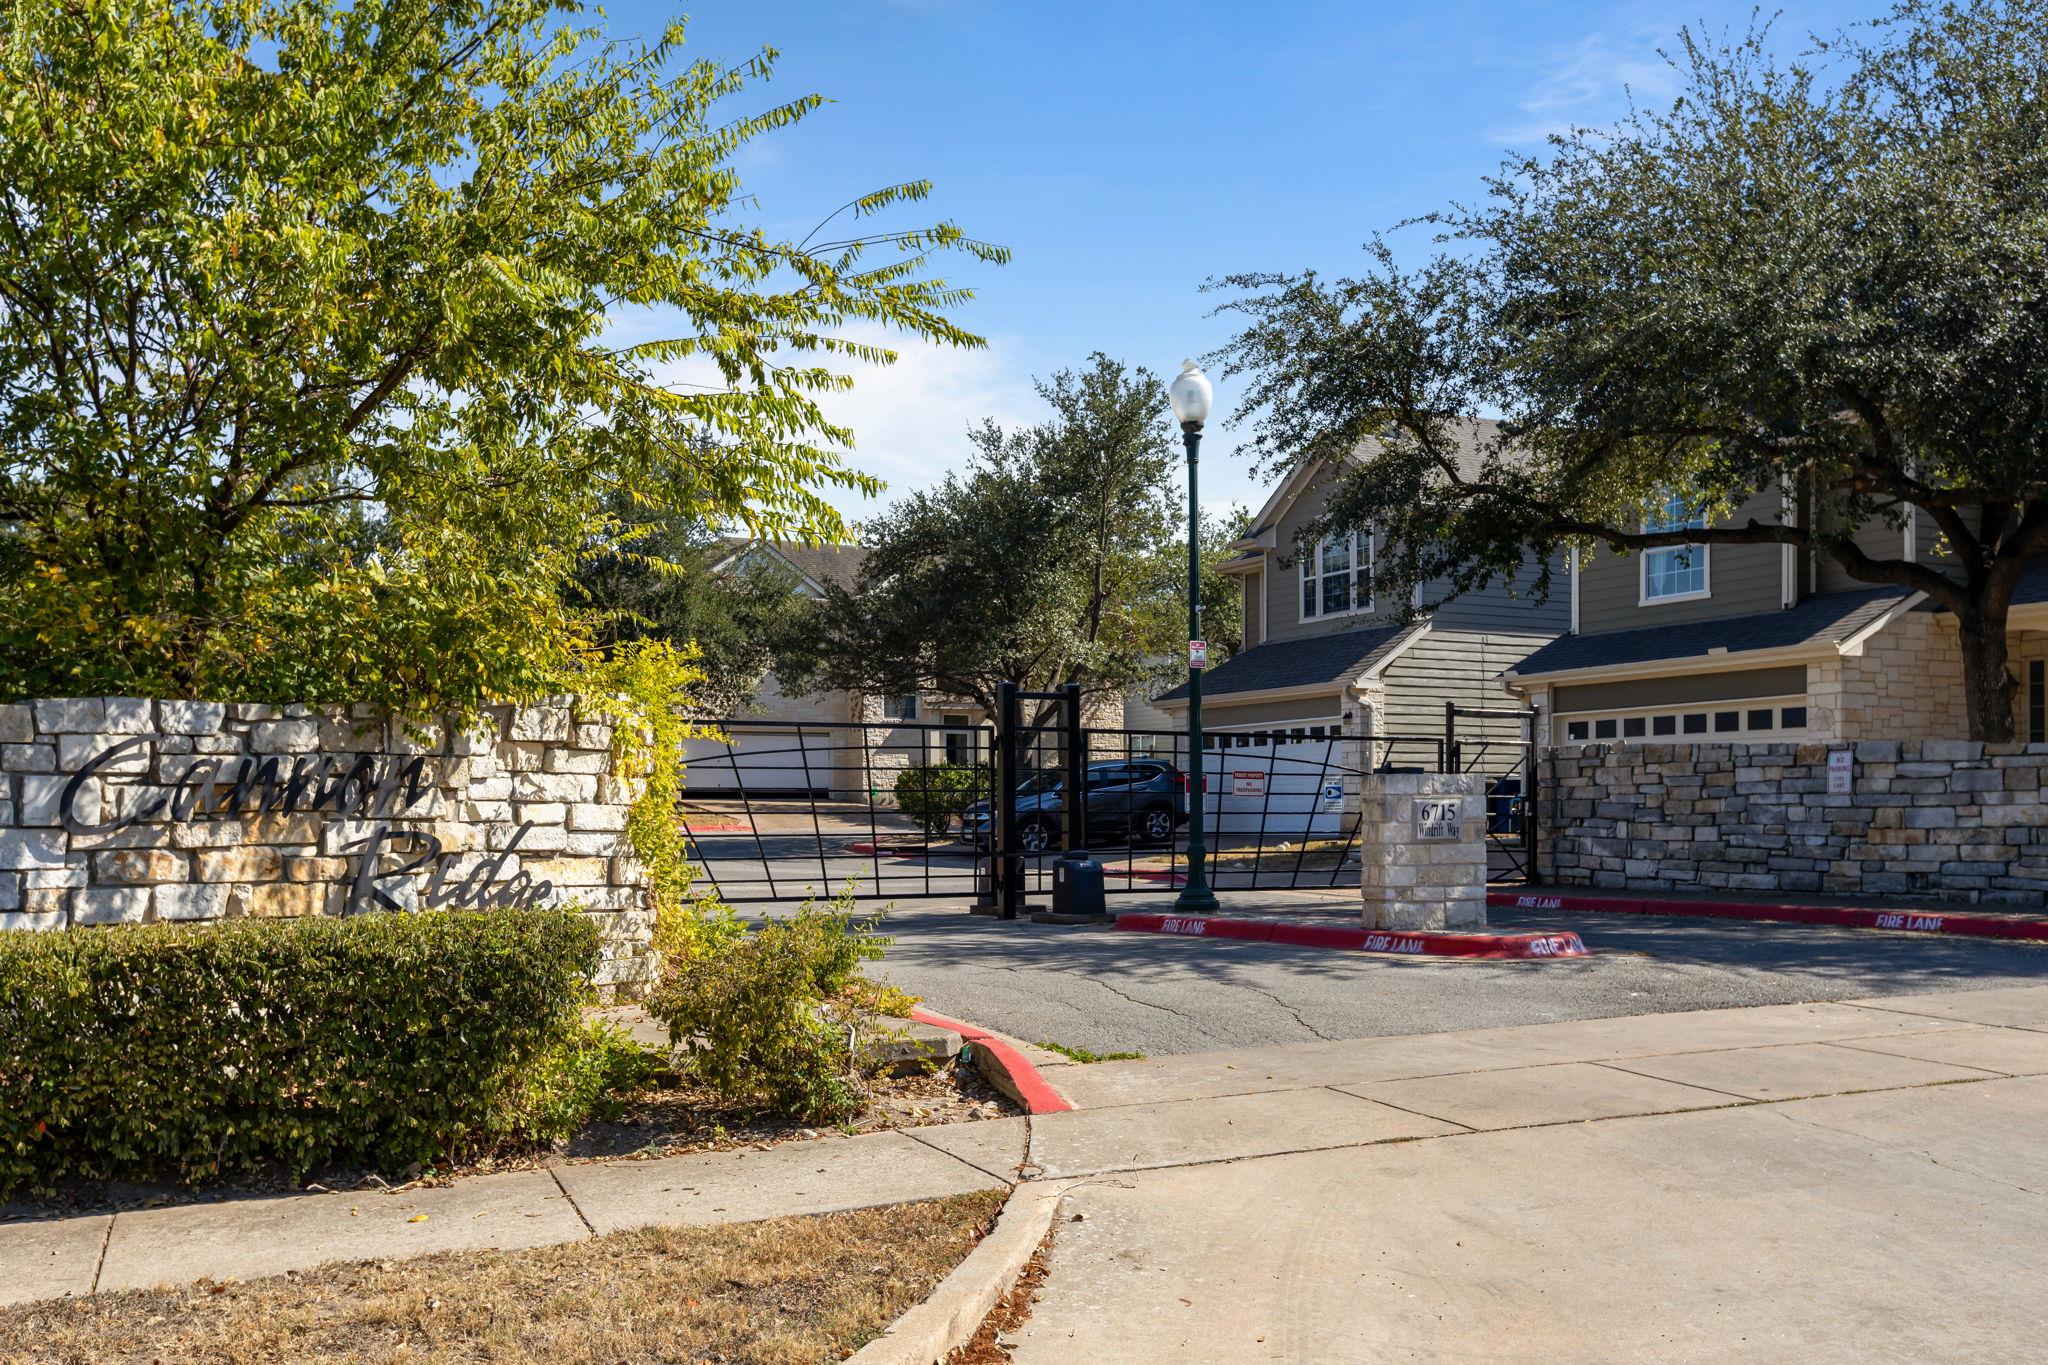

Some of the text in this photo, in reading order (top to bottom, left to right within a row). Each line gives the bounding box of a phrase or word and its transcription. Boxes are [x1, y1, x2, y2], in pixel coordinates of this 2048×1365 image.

[60, 733, 435, 835] Cannon
[1421, 804, 1456, 821] 6715
[1418, 823, 1459, 839] Windrift Way
[340, 820, 558, 919] Ridge
[1517, 896, 1561, 909] FIRE LANE
[1161, 919, 1206, 935] FIRE LANE
[1875, 914, 1943, 930] FIRE LANE
[1364, 934, 1424, 954] FIRE LANE
